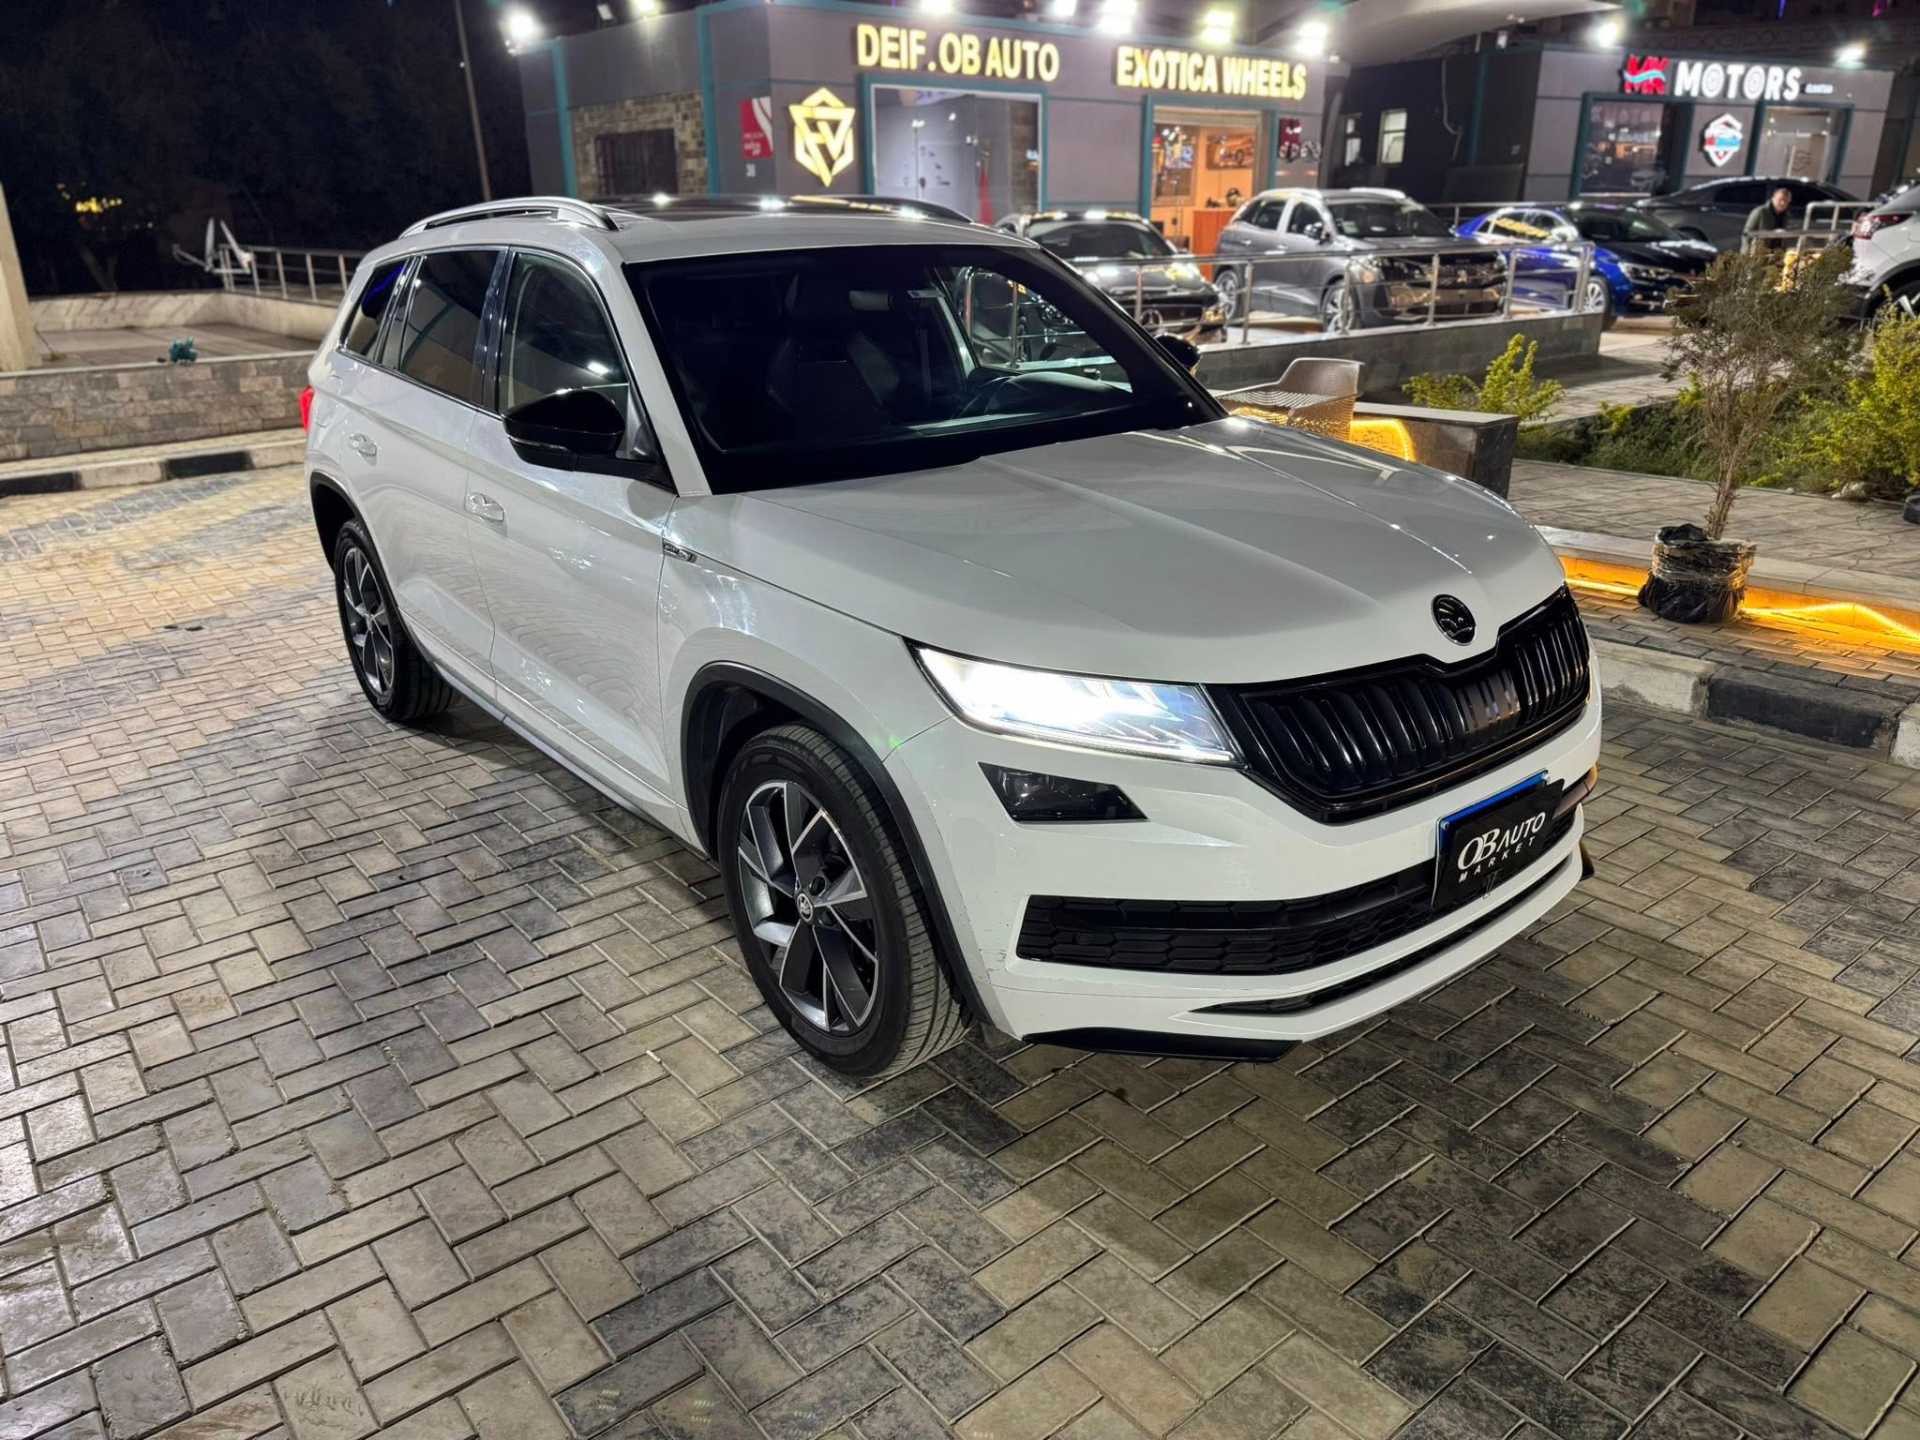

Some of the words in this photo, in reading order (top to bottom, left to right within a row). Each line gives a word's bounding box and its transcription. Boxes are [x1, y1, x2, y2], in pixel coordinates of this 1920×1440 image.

[985, 38, 1059, 82] AUTO
[1116, 46, 1217, 90] EXOTICA
[1221, 54, 1308, 100] WHEELS
[1674, 61, 1802, 101] MOTORS
[1459, 837, 1534, 882] MARKET
